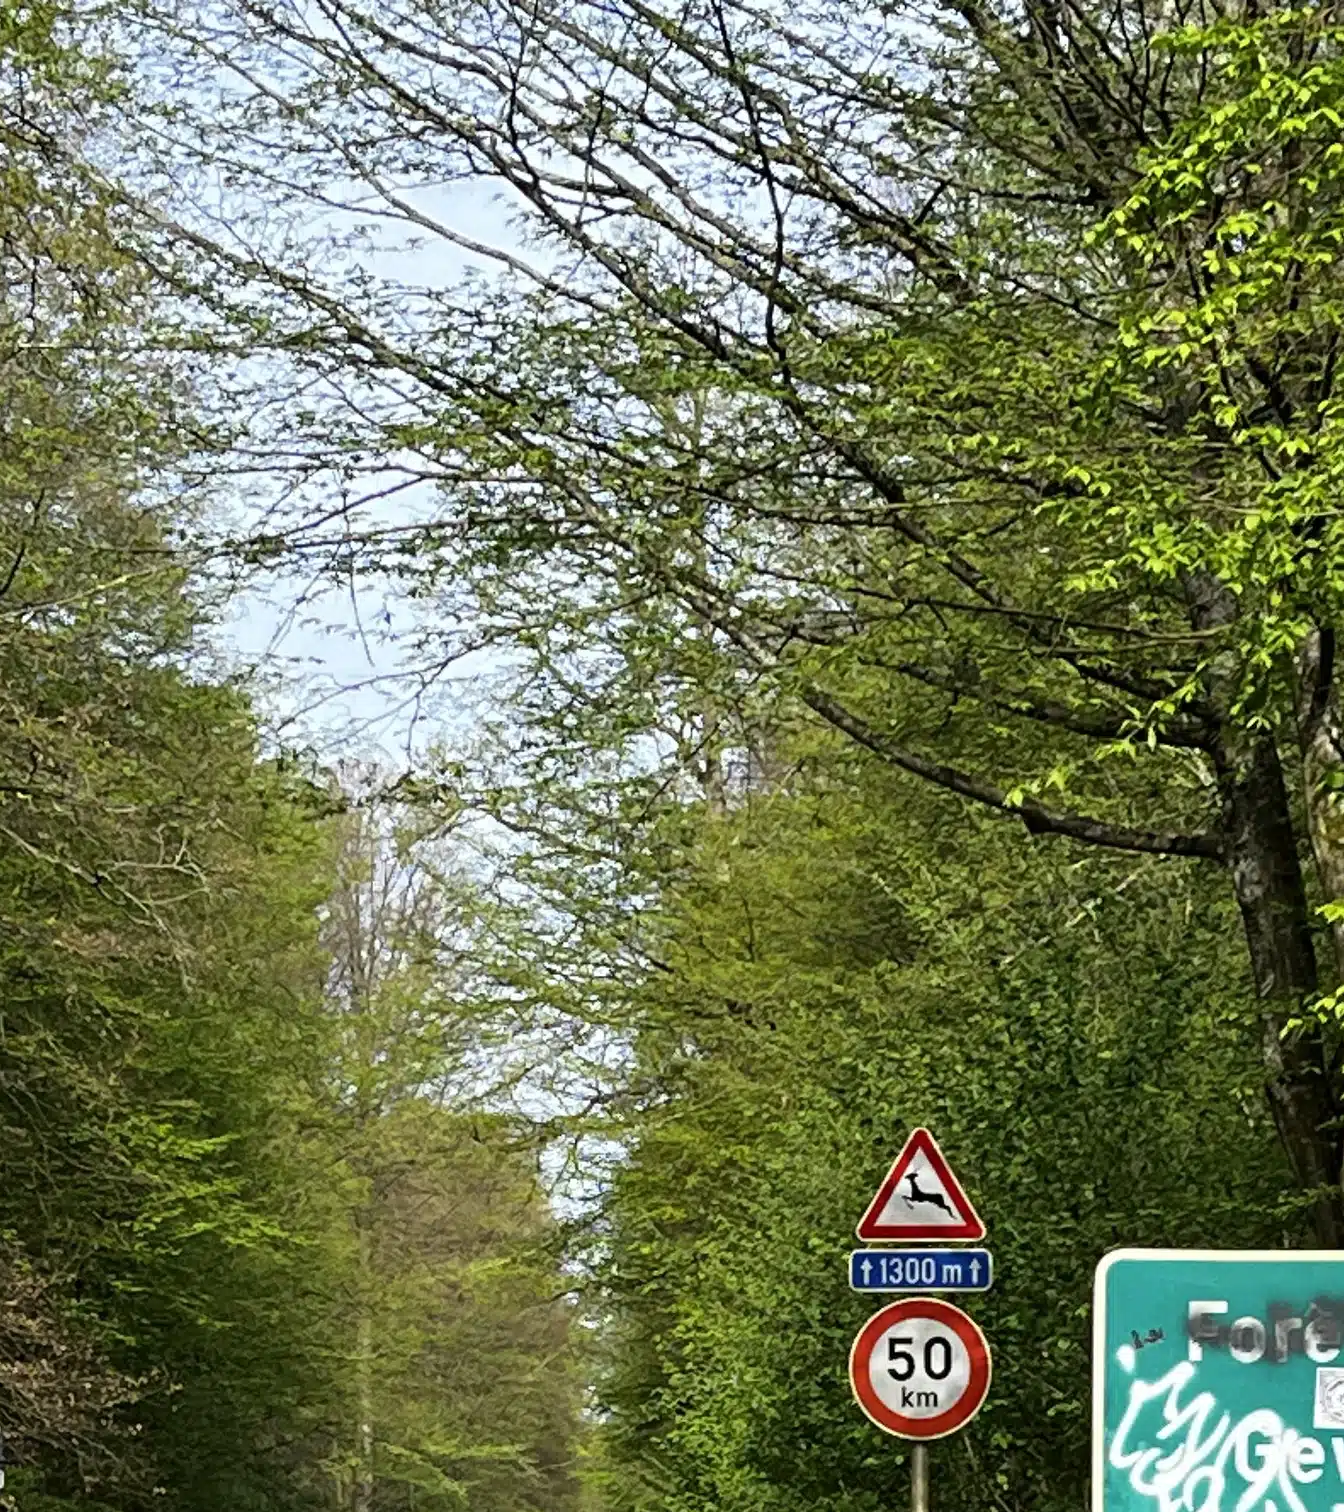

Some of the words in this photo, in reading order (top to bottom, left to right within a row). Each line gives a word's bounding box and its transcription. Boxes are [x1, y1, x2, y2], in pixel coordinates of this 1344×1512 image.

[879, 1257, 936, 1285] 1300
[942, 1263, 962, 1284] m
[887, 1336, 953, 1382] 50
[900, 1386, 939, 1409] km
